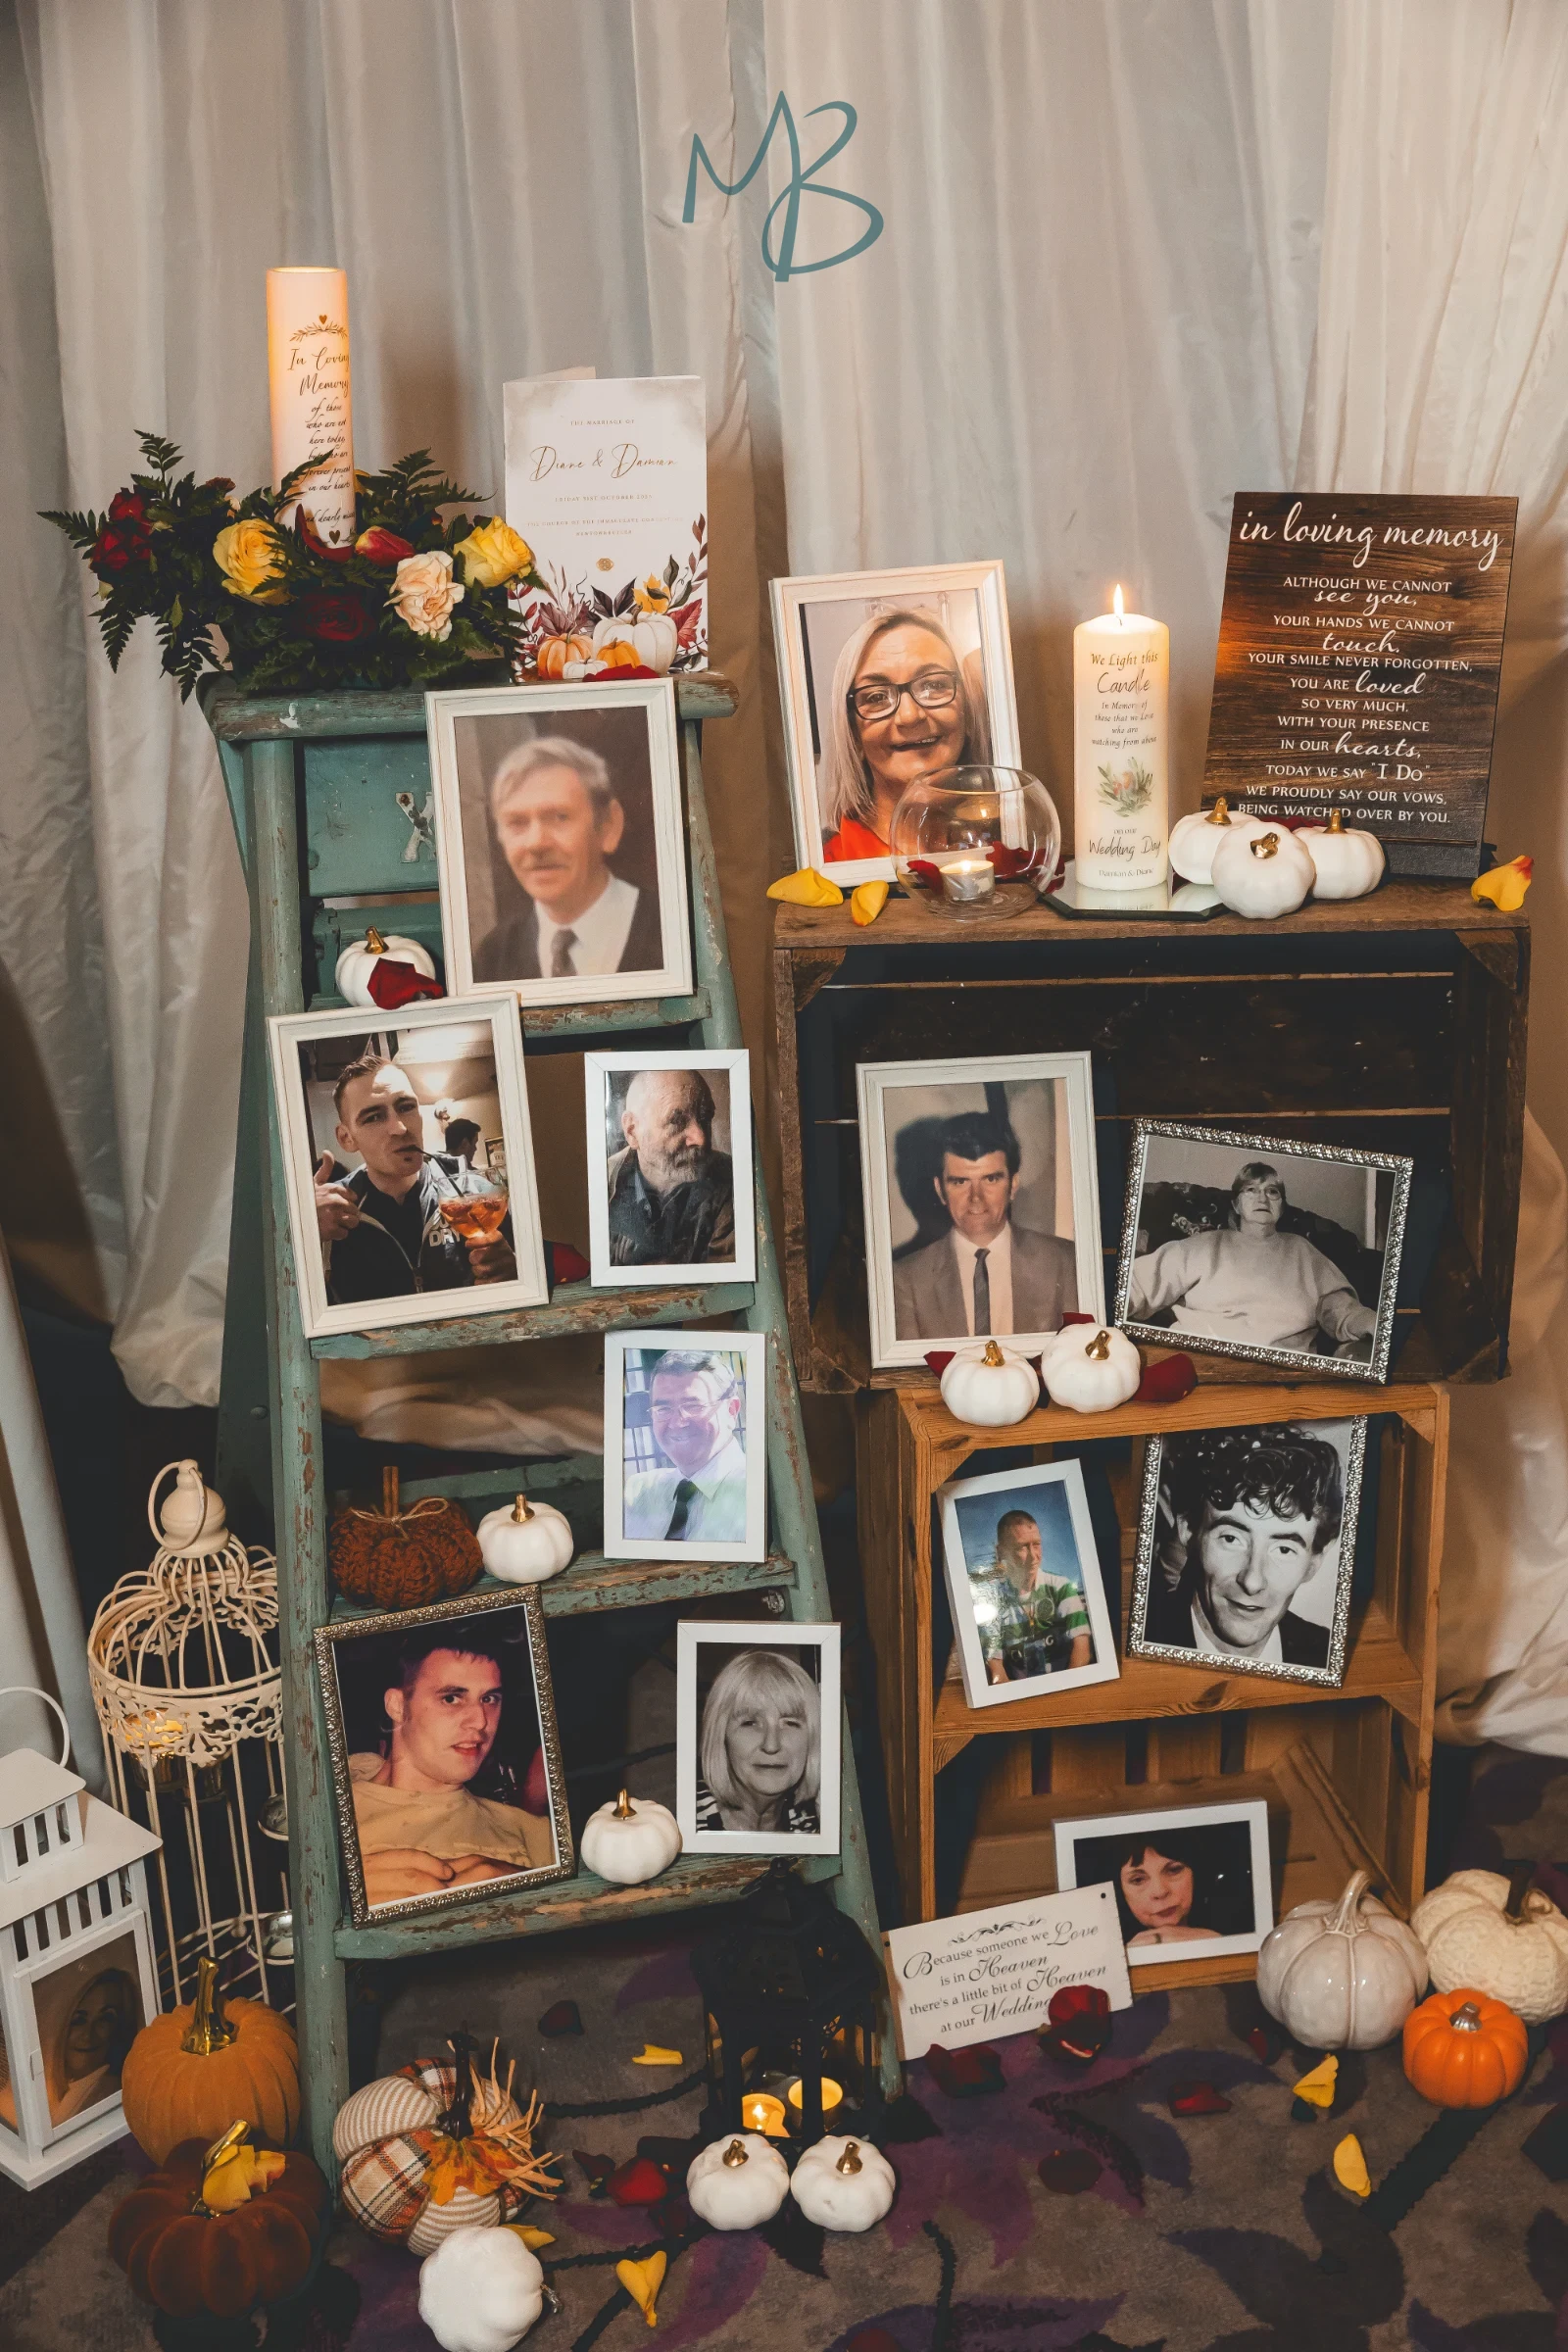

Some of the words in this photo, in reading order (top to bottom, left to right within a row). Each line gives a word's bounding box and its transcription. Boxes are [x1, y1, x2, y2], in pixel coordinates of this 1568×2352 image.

[287, 348, 307, 370] In
[312, 347, 350, 372] Loving
[300, 373, 349, 398] Memory
[305, 398, 326, 422] of
[306, 414, 324, 429] who
[309, 429, 324, 444] here
[529, 445, 585, 481] Diane
[592, 448, 604, 467] &
[305, 509, 321, 522] nd
[1240, 511, 1276, 540] in
[1283, 501, 1377, 568] loving
[1383, 526, 1503, 572] memory
[1283, 576, 1360, 590] ALTHOUGH
[1365, 579, 1387, 591] WE
[1393, 580, 1452, 593] CANNOT
[1313, 590, 1356, 603] see
[1363, 590, 1418, 616] you,
[1273, 614, 1310, 627] YOUR
[1316, 616, 1363, 628] HANDS
[1368, 618, 1390, 629] WE
[1396, 619, 1455, 632] CANNOT
[1322, 629, 1400, 654] touch.
[1091, 653, 1105, 665] We
[1108, 652, 1138, 671] Light
[1142, 649, 1158, 664] this
[1249, 653, 1285, 664] YOUR
[1290, 654, 1331, 666] SMILE
[1335, 656, 1380, 668] NEVER
[1384, 658, 1473, 673] FORGOTTEN,
[1097, 667, 1151, 694] Candle
[1290, 677, 1318, 689] YOU
[1323, 679, 1349, 691] ARE
[1354, 669, 1427, 695] loved
[1111, 700, 1139, 710] Memor
[1301, 698, 1320, 710] SO
[1325, 699, 1359, 711] VERY
[1362, 700, 1409, 712] MUCH.
[1095, 711, 1111, 722] those
[1113, 713, 1128, 722] that
[1277, 715, 1314, 728] WITH
[1319, 717, 1356, 729] YOUR
[1361, 719, 1430, 732] PRESENCE
[1111, 724, 1125, 734] who
[1091, 737, 1121, 750] watching
[1122, 737, 1140, 750] from
[1280, 739, 1295, 750] IN
[1299, 740, 1330, 751] OUR
[1334, 731, 1422, 759] hearts,
[1265, 764, 1313, 777] TODAY
[1316, 766, 1338, 778] WE
[1343, 767, 1367, 779] SAY
[1246, 785, 1267, 797] WE
[1272, 785, 1336, 800] PROUDLY
[1339, 789, 1363, 801] SAY
[1367, 790, 1398, 803] OUR
[1402, 792, 1448, 806] VOWS,
[1238, 803, 1279, 815] BEING
[1283, 805, 1351, 819] WATCHD
[1355, 808, 1394, 821] OVER
[1397, 810, 1415, 822] BY
[1419, 811, 1451, 823] YOU.
[1089, 836, 1136, 862] Wedding
[1141, 835, 1161, 858] Day
[903, 1950, 973, 1980] Because
[976, 1936, 1028, 1956] someone
[1031, 1931, 1050, 1941] we
[1047, 1921, 1099, 1946] Love
[940, 1975, 951, 1986] is
[953, 1971, 965, 1984] in
[968, 1955, 1049, 1982] Heaven
[909, 1998, 949, 2016] there's
[952, 1996, 959, 2005] a
[961, 1986, 989, 2003] little
[991, 1983, 1008, 1996] bit
[1010, 1979, 1023, 1990] of
[1026, 1965, 1106, 1992] Heaven
[940, 2023, 952, 2034] at
[955, 2016, 976, 2031] our
